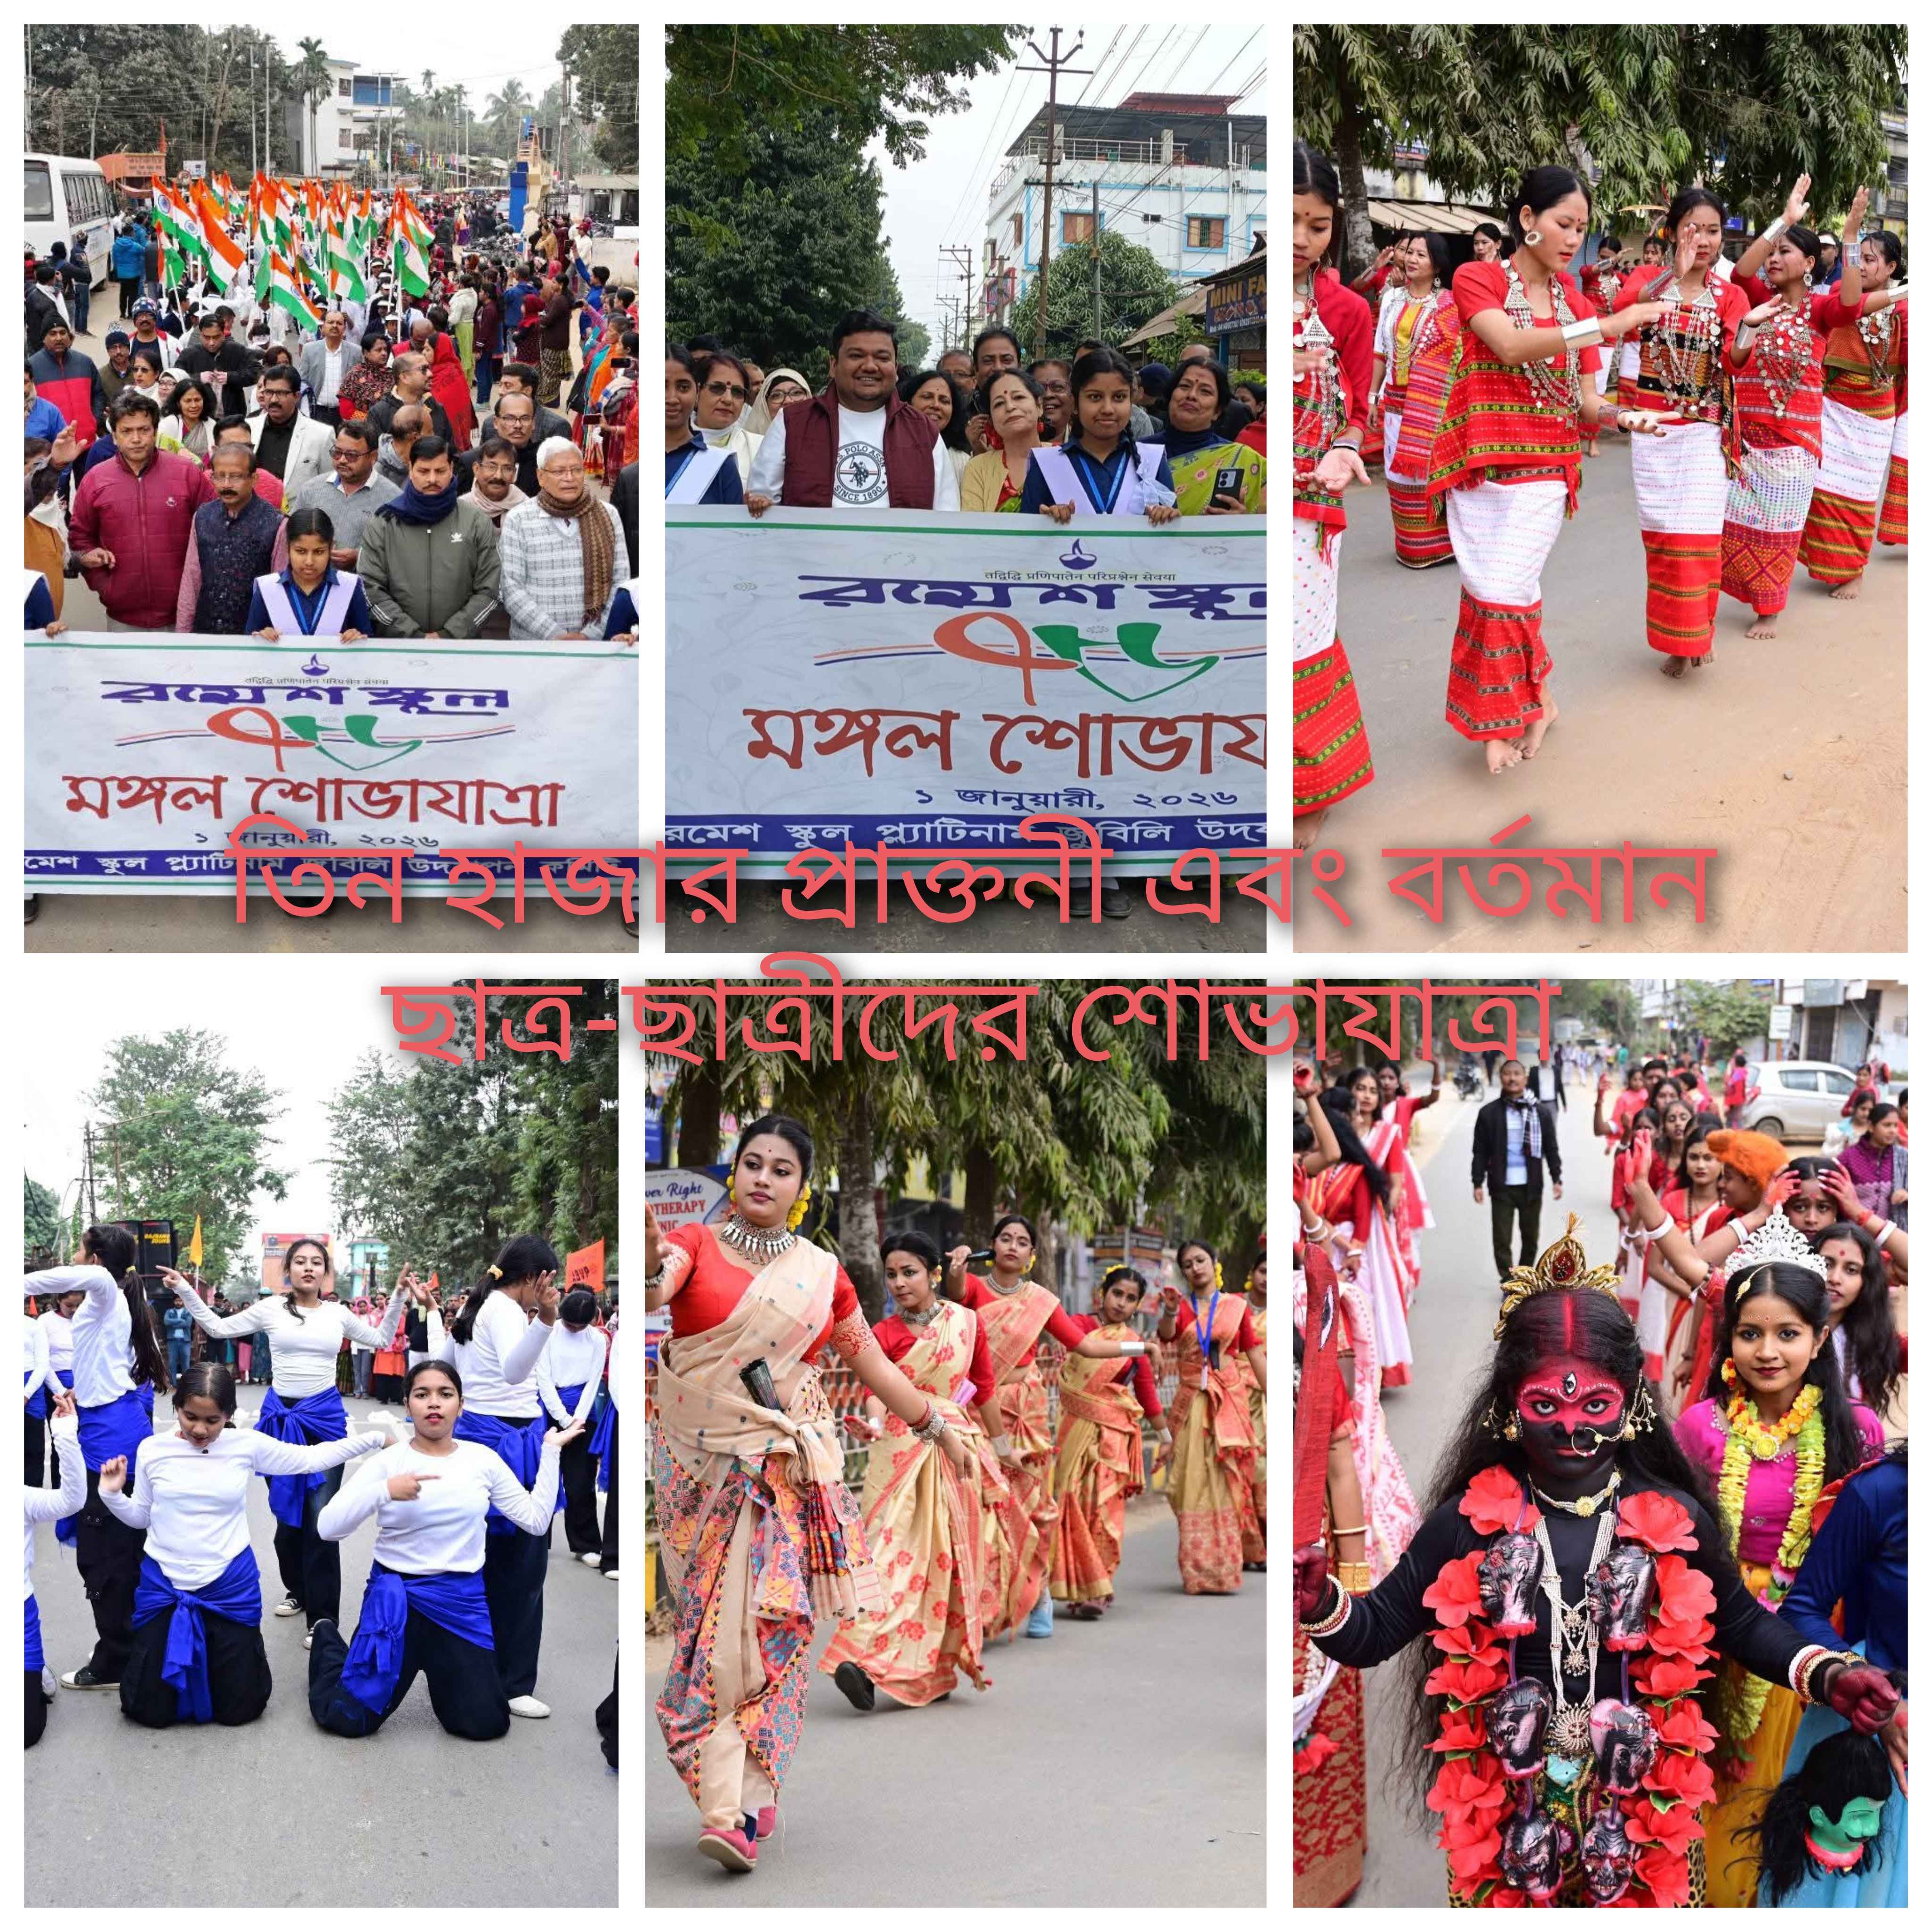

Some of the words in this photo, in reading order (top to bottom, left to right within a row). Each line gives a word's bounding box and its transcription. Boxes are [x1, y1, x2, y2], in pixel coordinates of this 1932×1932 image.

[1210, 280, 1242, 308] MINI
[845, 445, 868, 454] POLO
[834, 485, 859, 500] SINCE
[863, 486, 883, 500] 1890
[1027, 571, 1083, 581] प्रणिपातेन
[1142, 573, 1176, 581] सेवया
[1133, 583, 1266, 620] স্কু
[357, 687, 509, 716] স্কুল
[743, 708, 960, 777] মঙ্গল
[62, 775, 228, 824] মঙ্গল
[245, 776, 566, 827] শোভাযাত্রা
[915, 789, 933, 804] ১
[955, 787, 1105, 813] জানুয়ারী,
[1133, 792, 1239, 809] ২০২৬
[195, 833, 209, 844] ১
[358, 834, 439, 848] ২০২৬
[665, 823, 762, 844] রমেশ
[783, 822, 855, 849] স্কুল
[95, 857, 149, 876] স্কুল
[667, 1182, 703, 1200] Right
